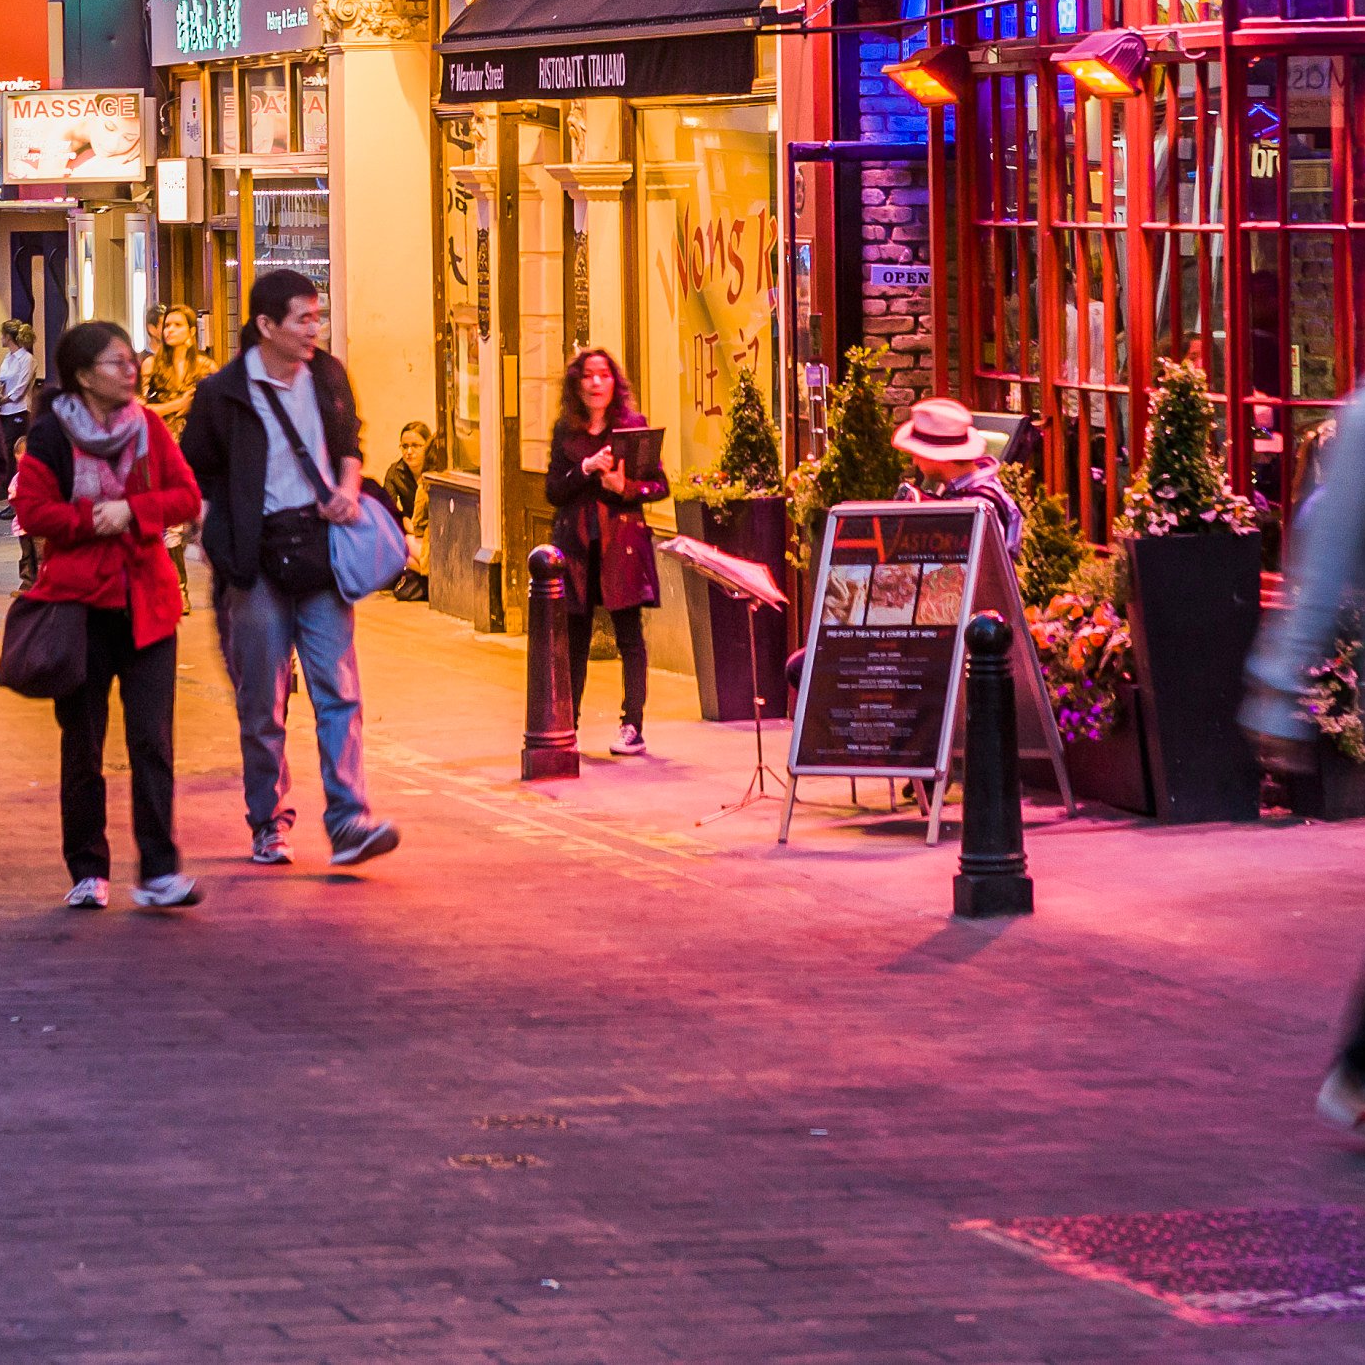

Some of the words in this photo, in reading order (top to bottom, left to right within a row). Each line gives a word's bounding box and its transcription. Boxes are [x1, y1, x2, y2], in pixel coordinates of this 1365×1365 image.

[587, 52, 626, 87] ITALIANO
[13, 97, 136, 119] MASSAGE
[882, 270, 930, 284] OPEN
